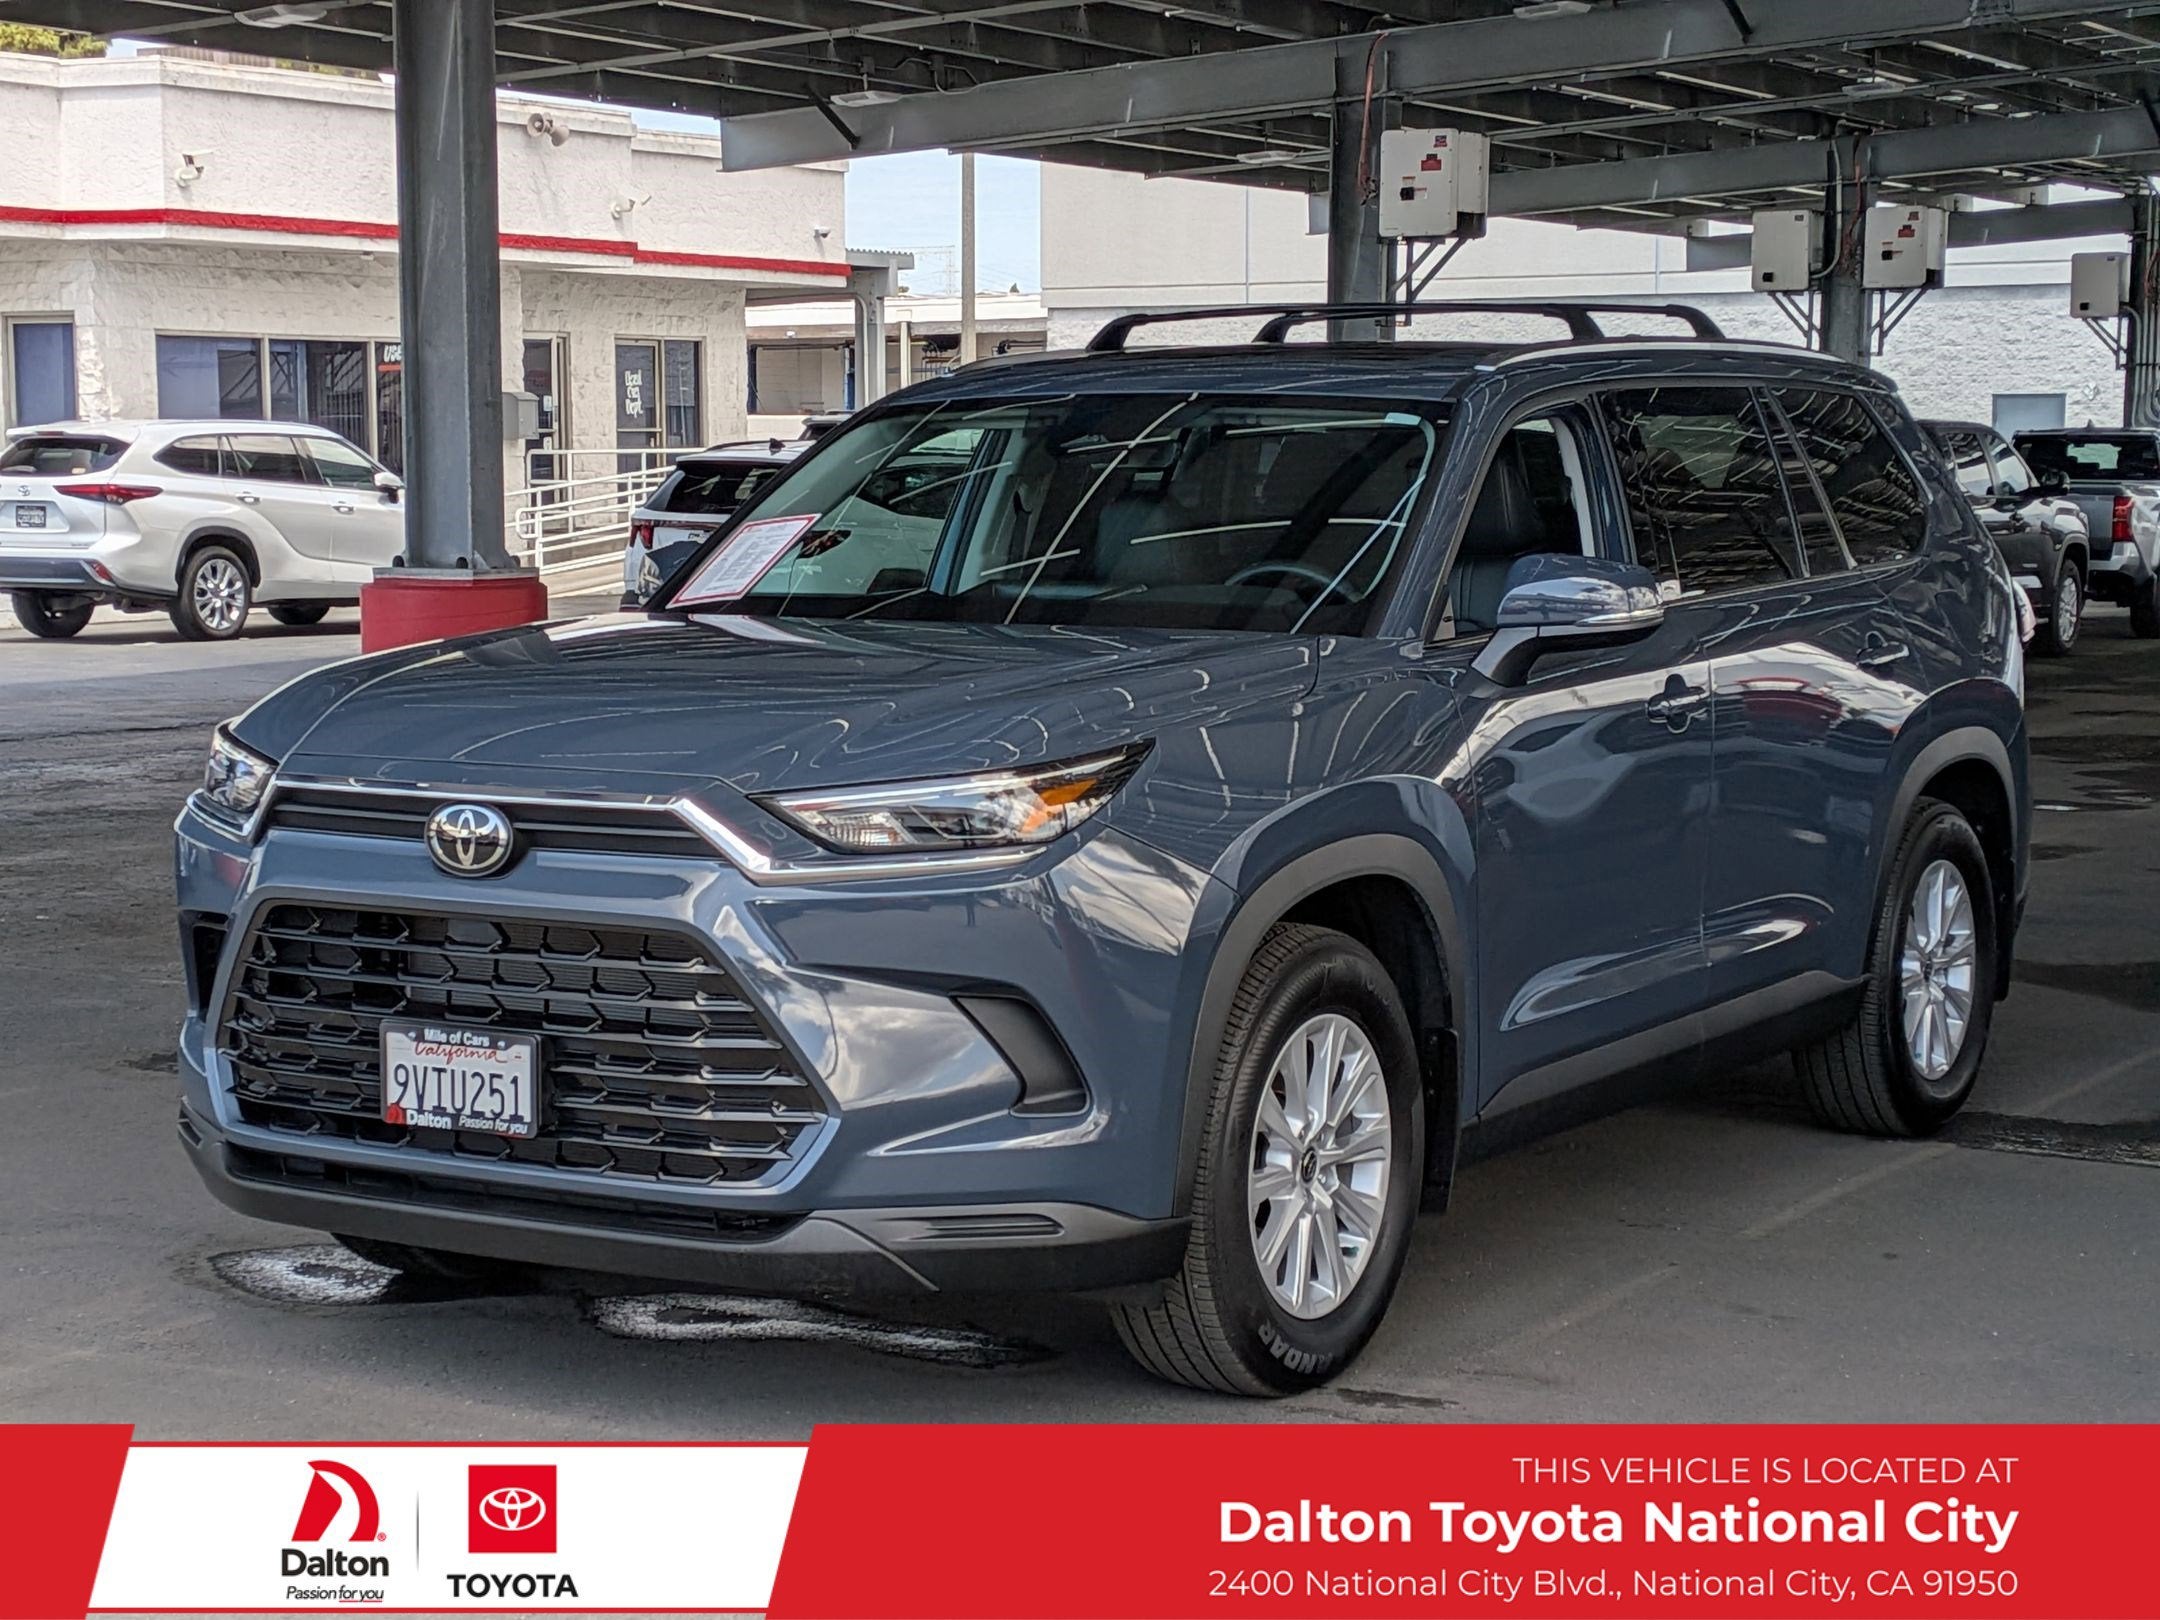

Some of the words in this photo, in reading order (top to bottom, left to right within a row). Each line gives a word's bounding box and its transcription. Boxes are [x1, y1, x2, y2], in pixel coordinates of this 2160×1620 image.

[424, 1028, 447, 1043] Mile
[450, 1031, 462, 1044] of
[463, 1032, 490, 1047] Cars
[415, 1041, 508, 1065] California
[394, 1063, 525, 1122] 9VIU251
[407, 1109, 451, 1130] Dalton
[458, 1115, 494, 1130] Passion
[494, 1119, 508, 1132] for
[507, 1122, 528, 1134] you
